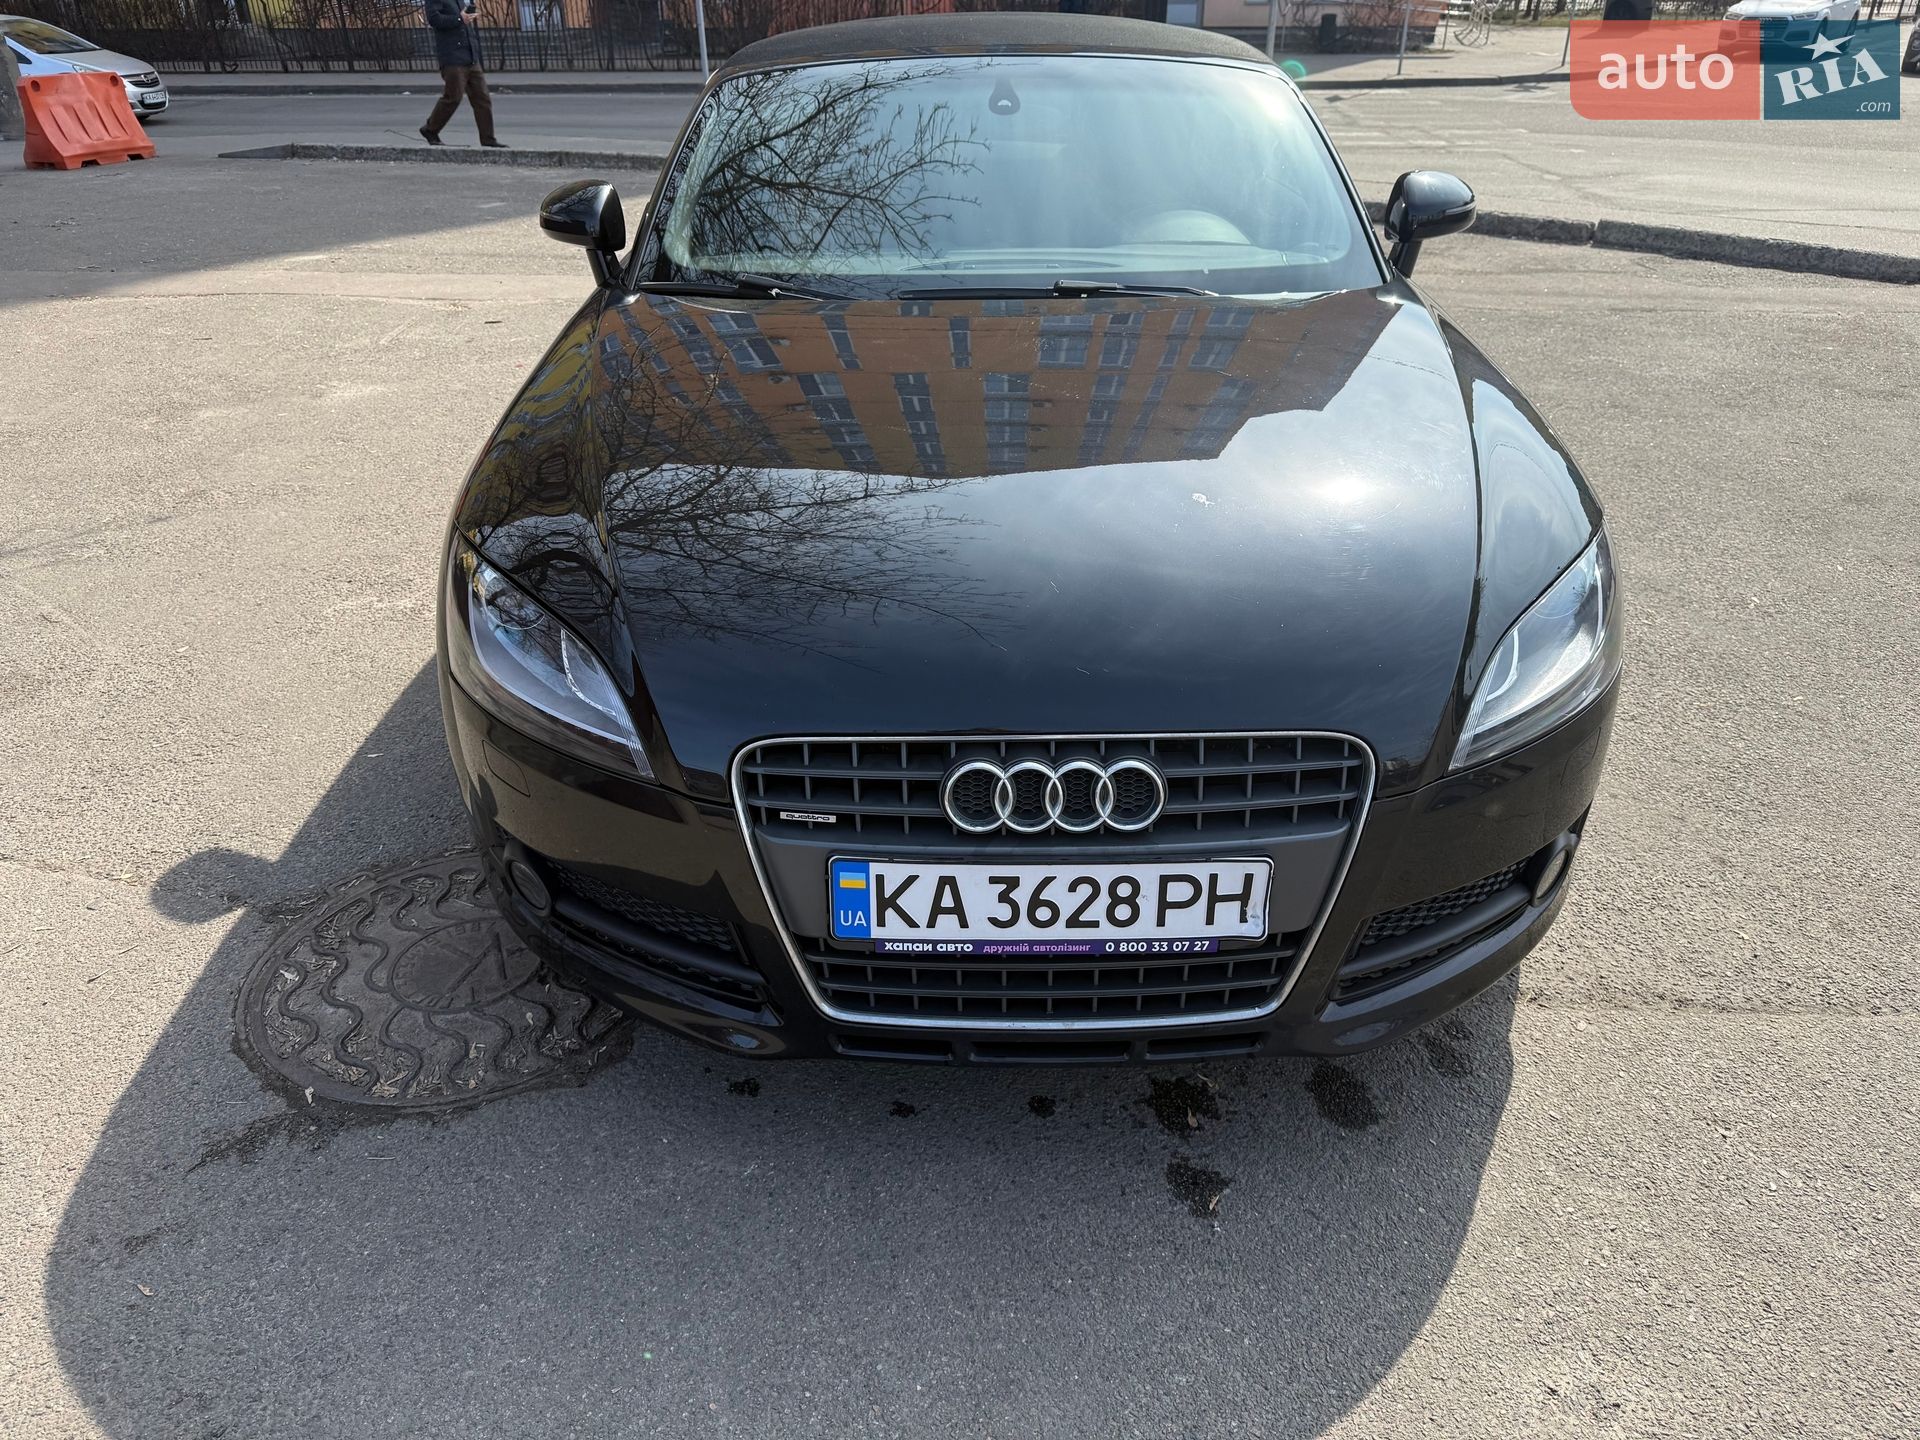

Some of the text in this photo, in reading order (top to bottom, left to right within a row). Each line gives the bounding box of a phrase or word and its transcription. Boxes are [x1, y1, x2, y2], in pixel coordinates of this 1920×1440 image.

[875, 873, 1254, 928] KA 3628 PH
[840, 910, 867, 927] UA
[936, 943, 973, 952] авто
[983, 944, 1029, 954] дружній
[1033, 944, 1091, 952] автолізинг
[1105, 942, 1115, 952] 0
[1119, 942, 1147, 952] 800
[1152, 942, 1168, 951] 33
[1173, 941, 1189, 951] 07
[1194, 941, 1209, 951] 27
